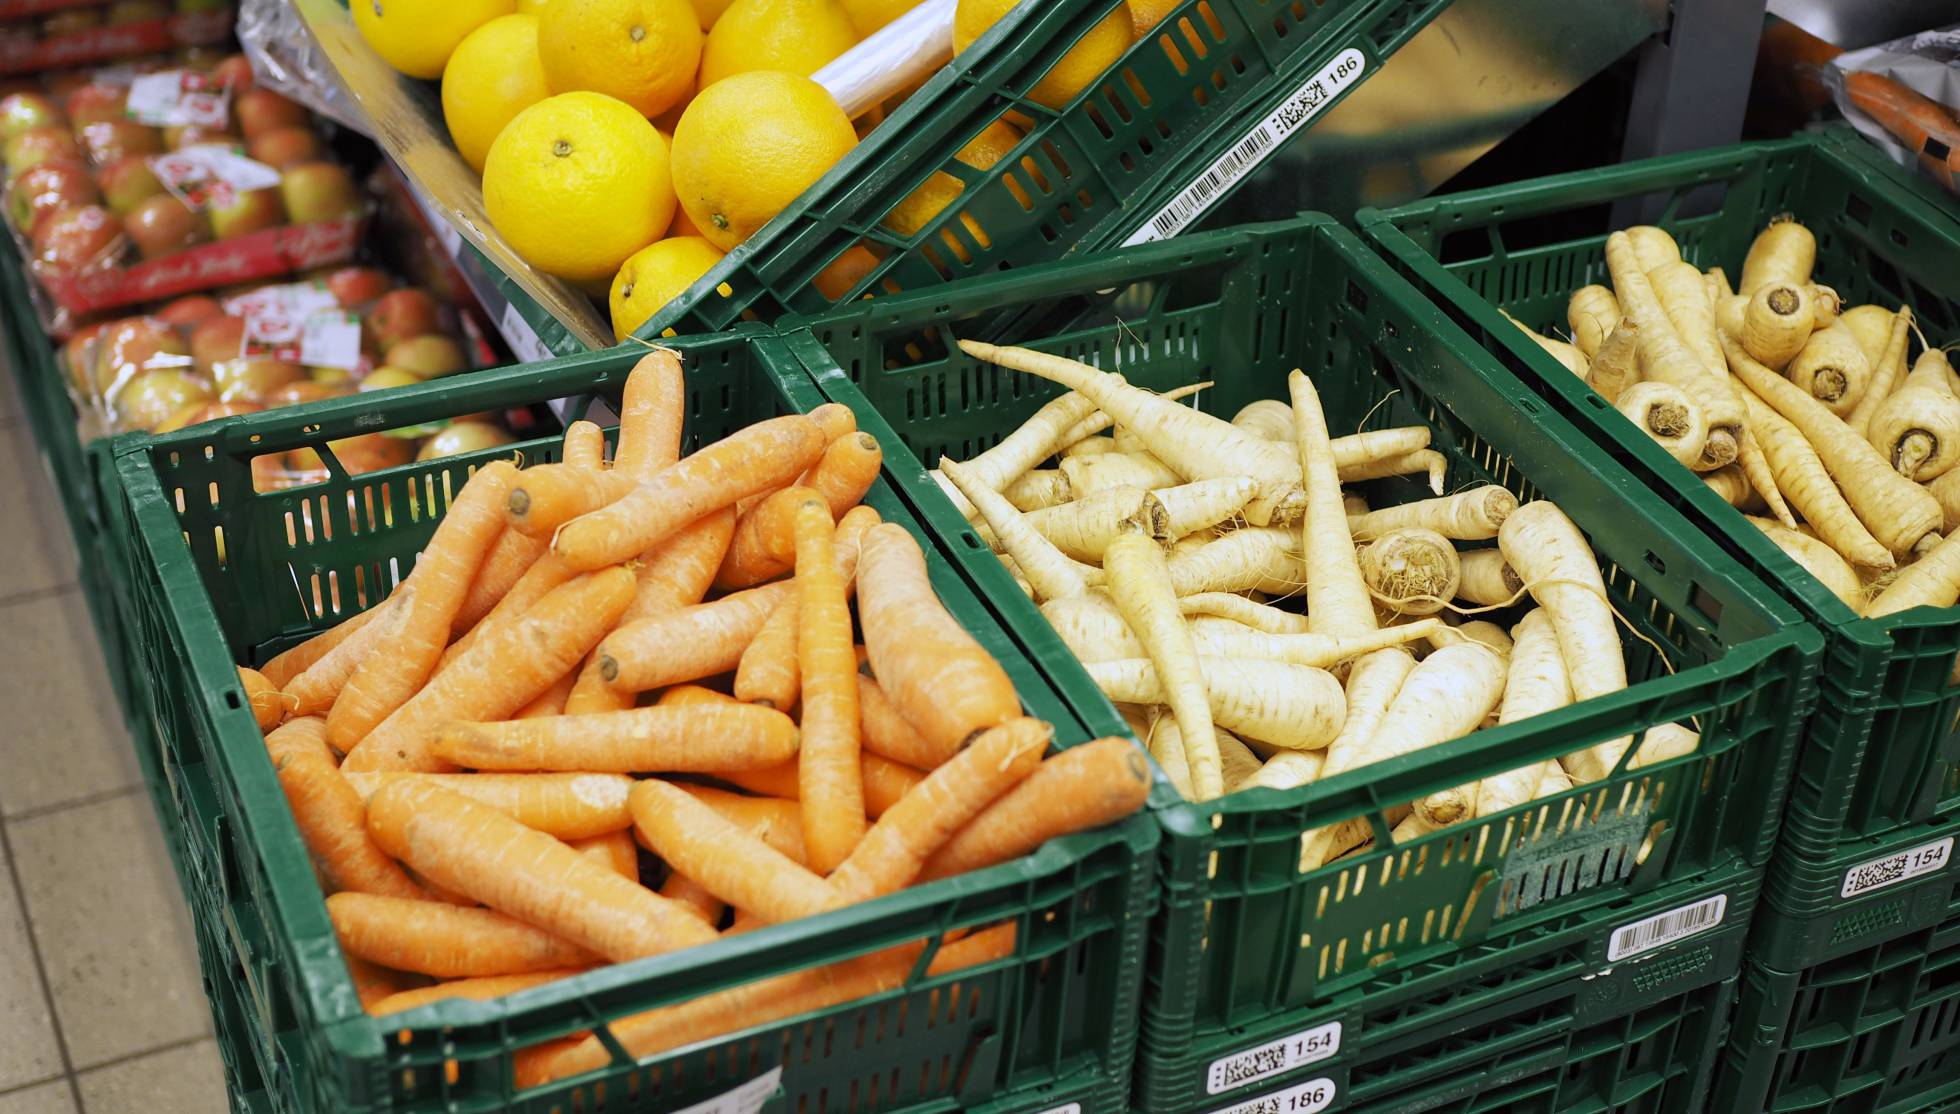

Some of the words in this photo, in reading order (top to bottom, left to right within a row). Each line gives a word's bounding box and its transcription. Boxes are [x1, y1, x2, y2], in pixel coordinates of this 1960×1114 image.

[1328, 56, 1357, 84] 186
[1914, 845, 1944, 867] 154
[1295, 1032, 1331, 1056] 154
[1288, 1087, 1324, 1111] 186
